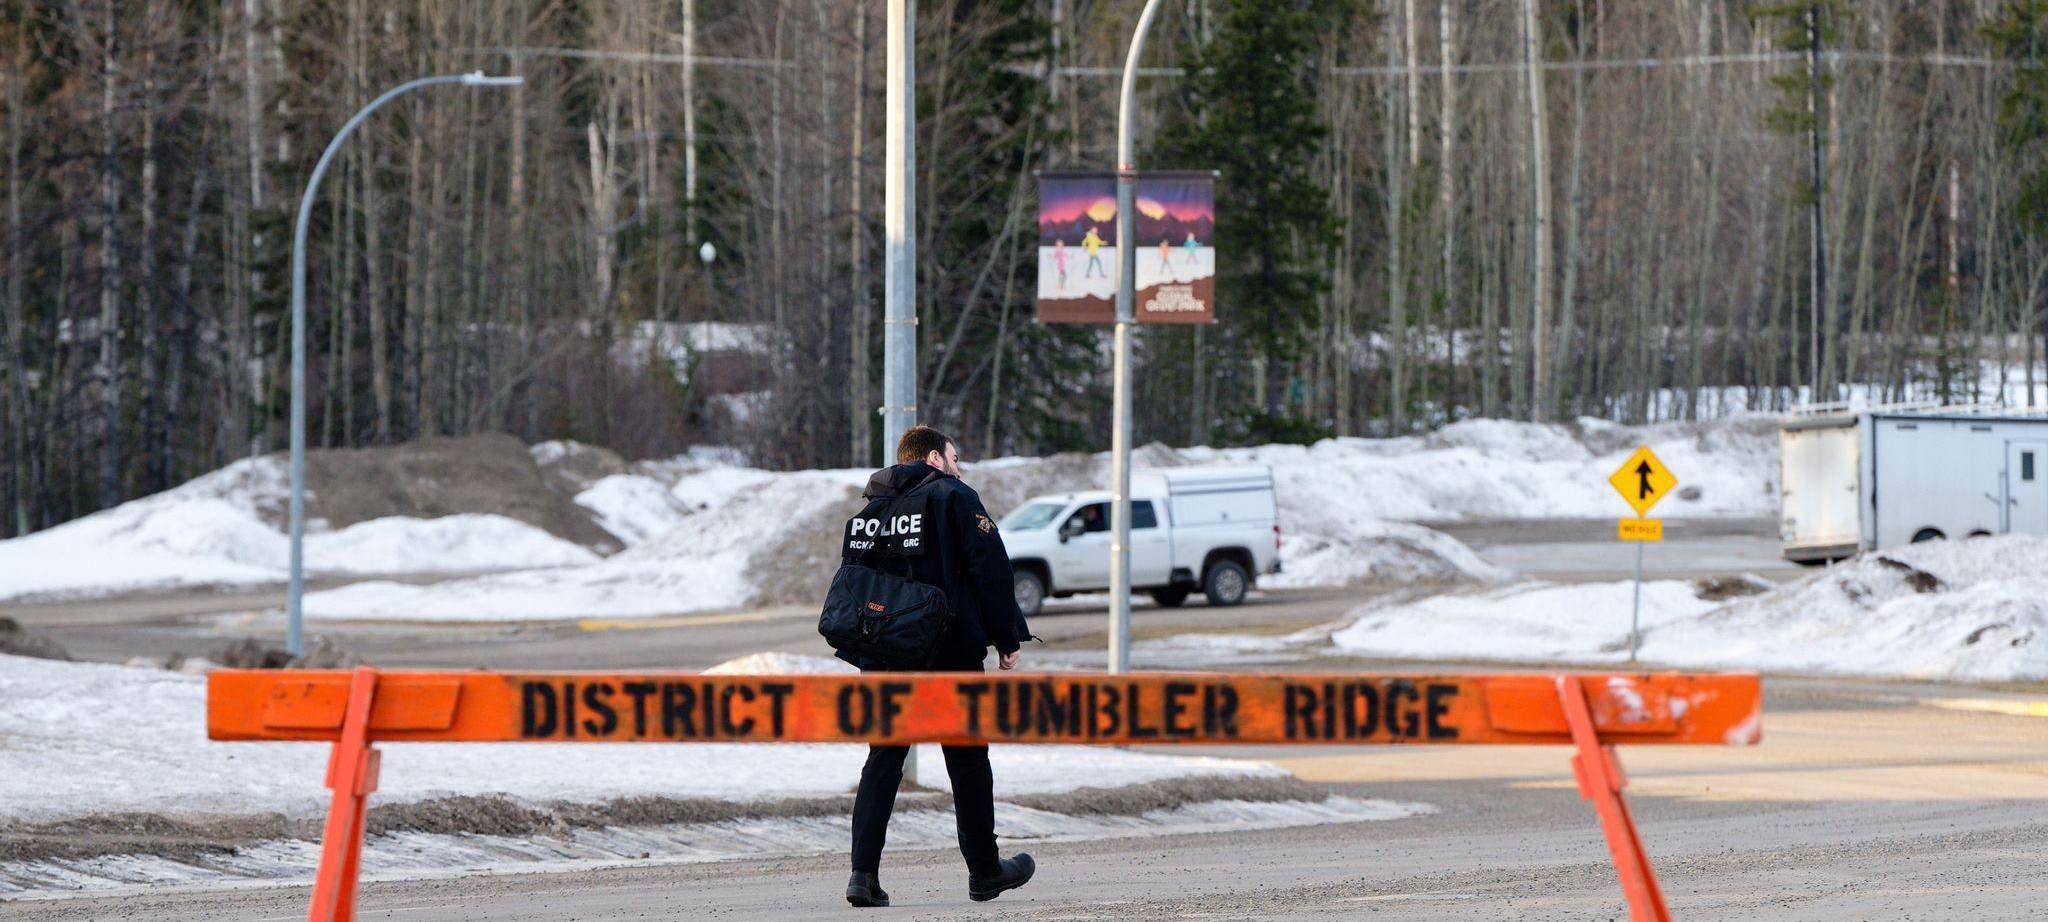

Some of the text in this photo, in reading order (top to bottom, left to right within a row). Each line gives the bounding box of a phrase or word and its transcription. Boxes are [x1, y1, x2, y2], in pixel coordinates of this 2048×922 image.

[850, 513, 922, 537] POLICE
[903, 537, 920, 548] GRC
[521, 679, 1460, 739] DISTRICT OF TUMBLER RIDGE
